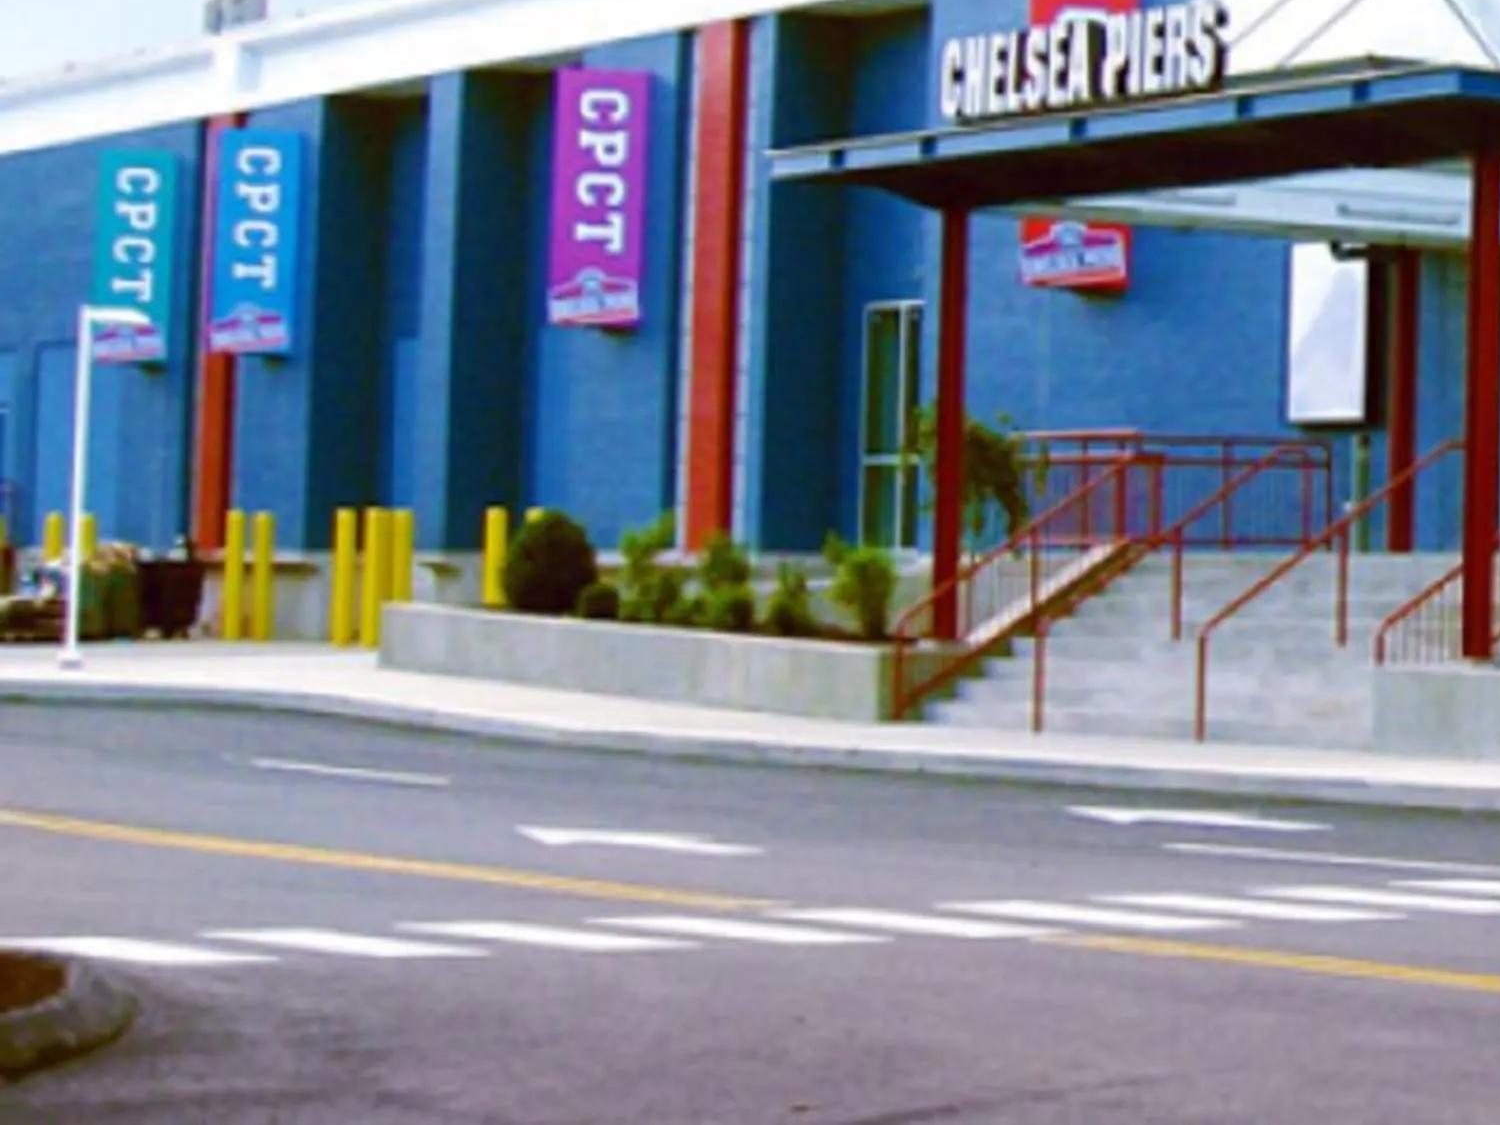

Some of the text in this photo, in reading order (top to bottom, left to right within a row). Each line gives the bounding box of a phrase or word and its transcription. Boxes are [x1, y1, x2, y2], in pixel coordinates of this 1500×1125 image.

[940, 0, 1220, 119] CHELSEA PIERS
[111, 167, 161, 302] CPCT
[233, 147, 281, 289] CPCT
[574, 88, 629, 254] CPCT
